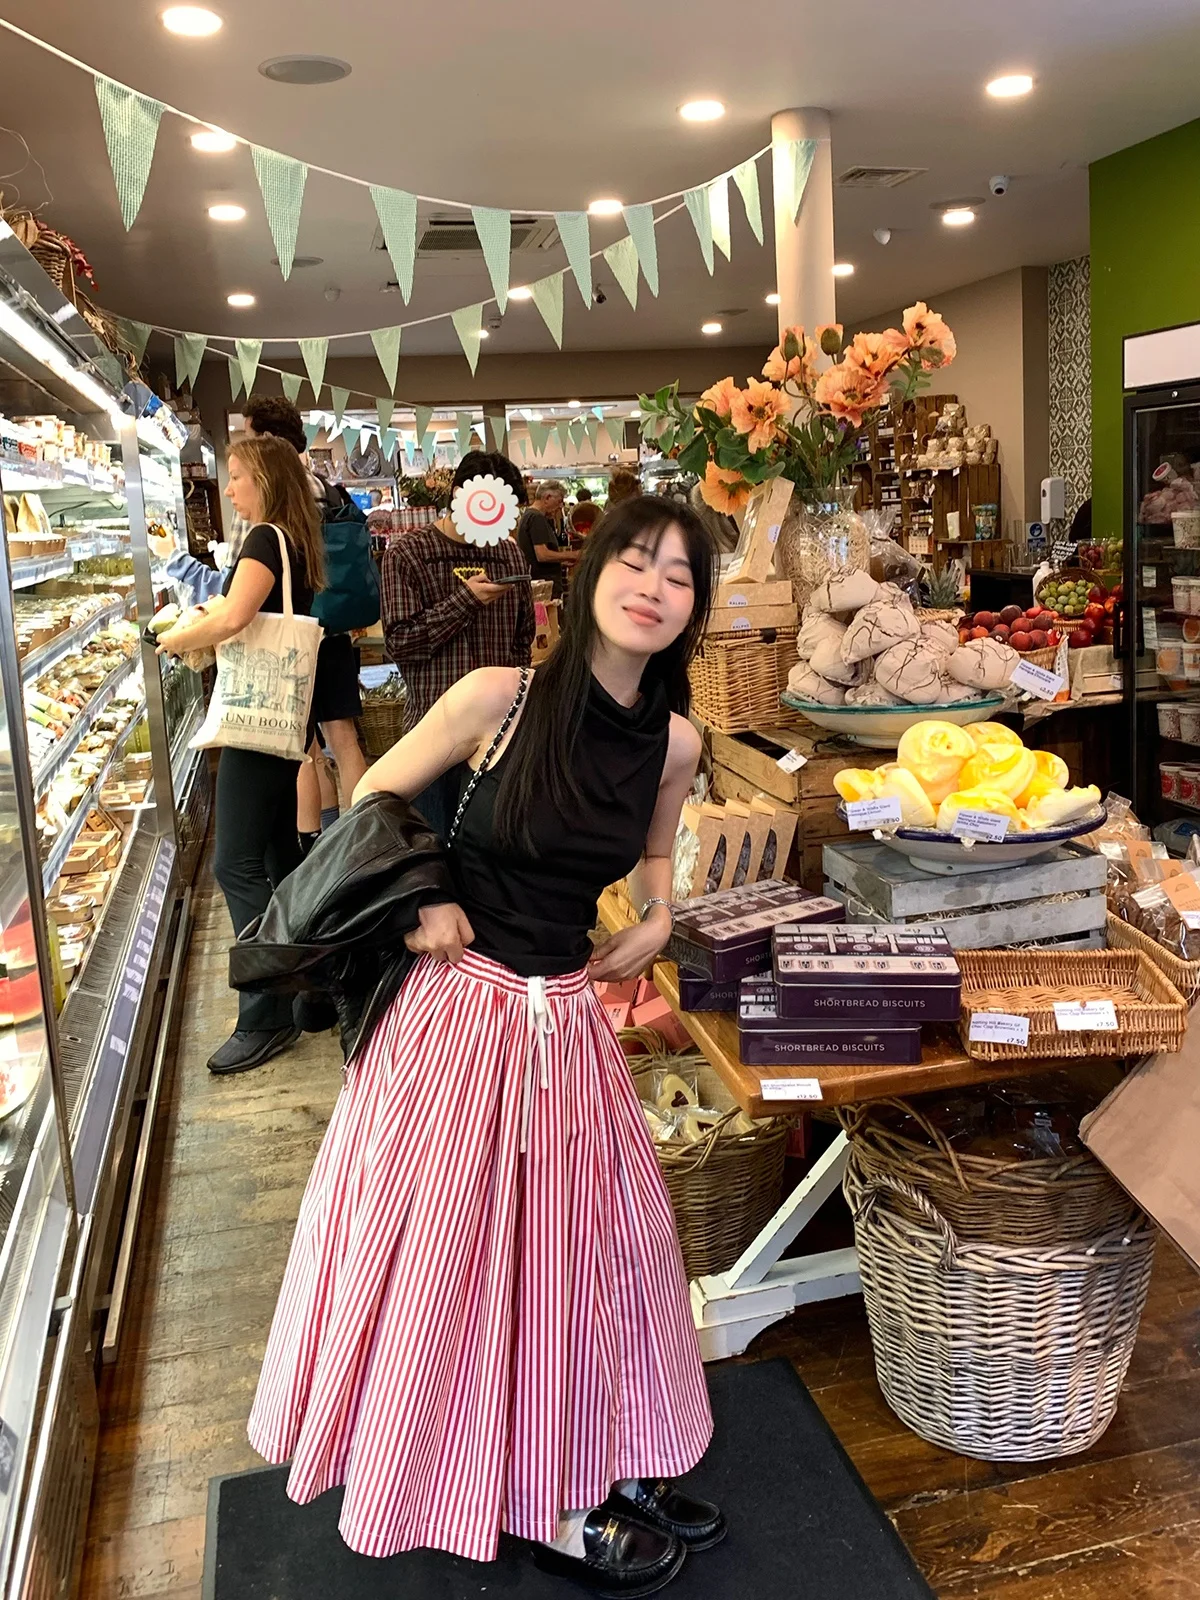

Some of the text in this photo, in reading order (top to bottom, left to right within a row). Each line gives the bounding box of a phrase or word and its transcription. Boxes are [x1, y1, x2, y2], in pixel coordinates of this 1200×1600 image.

[259, 716, 302, 730] BOOKS
[814, 999, 926, 1008] SHORTBREAD BISCUITS
[774, 1043, 886, 1052] SHORTBREAD BISCUITS
